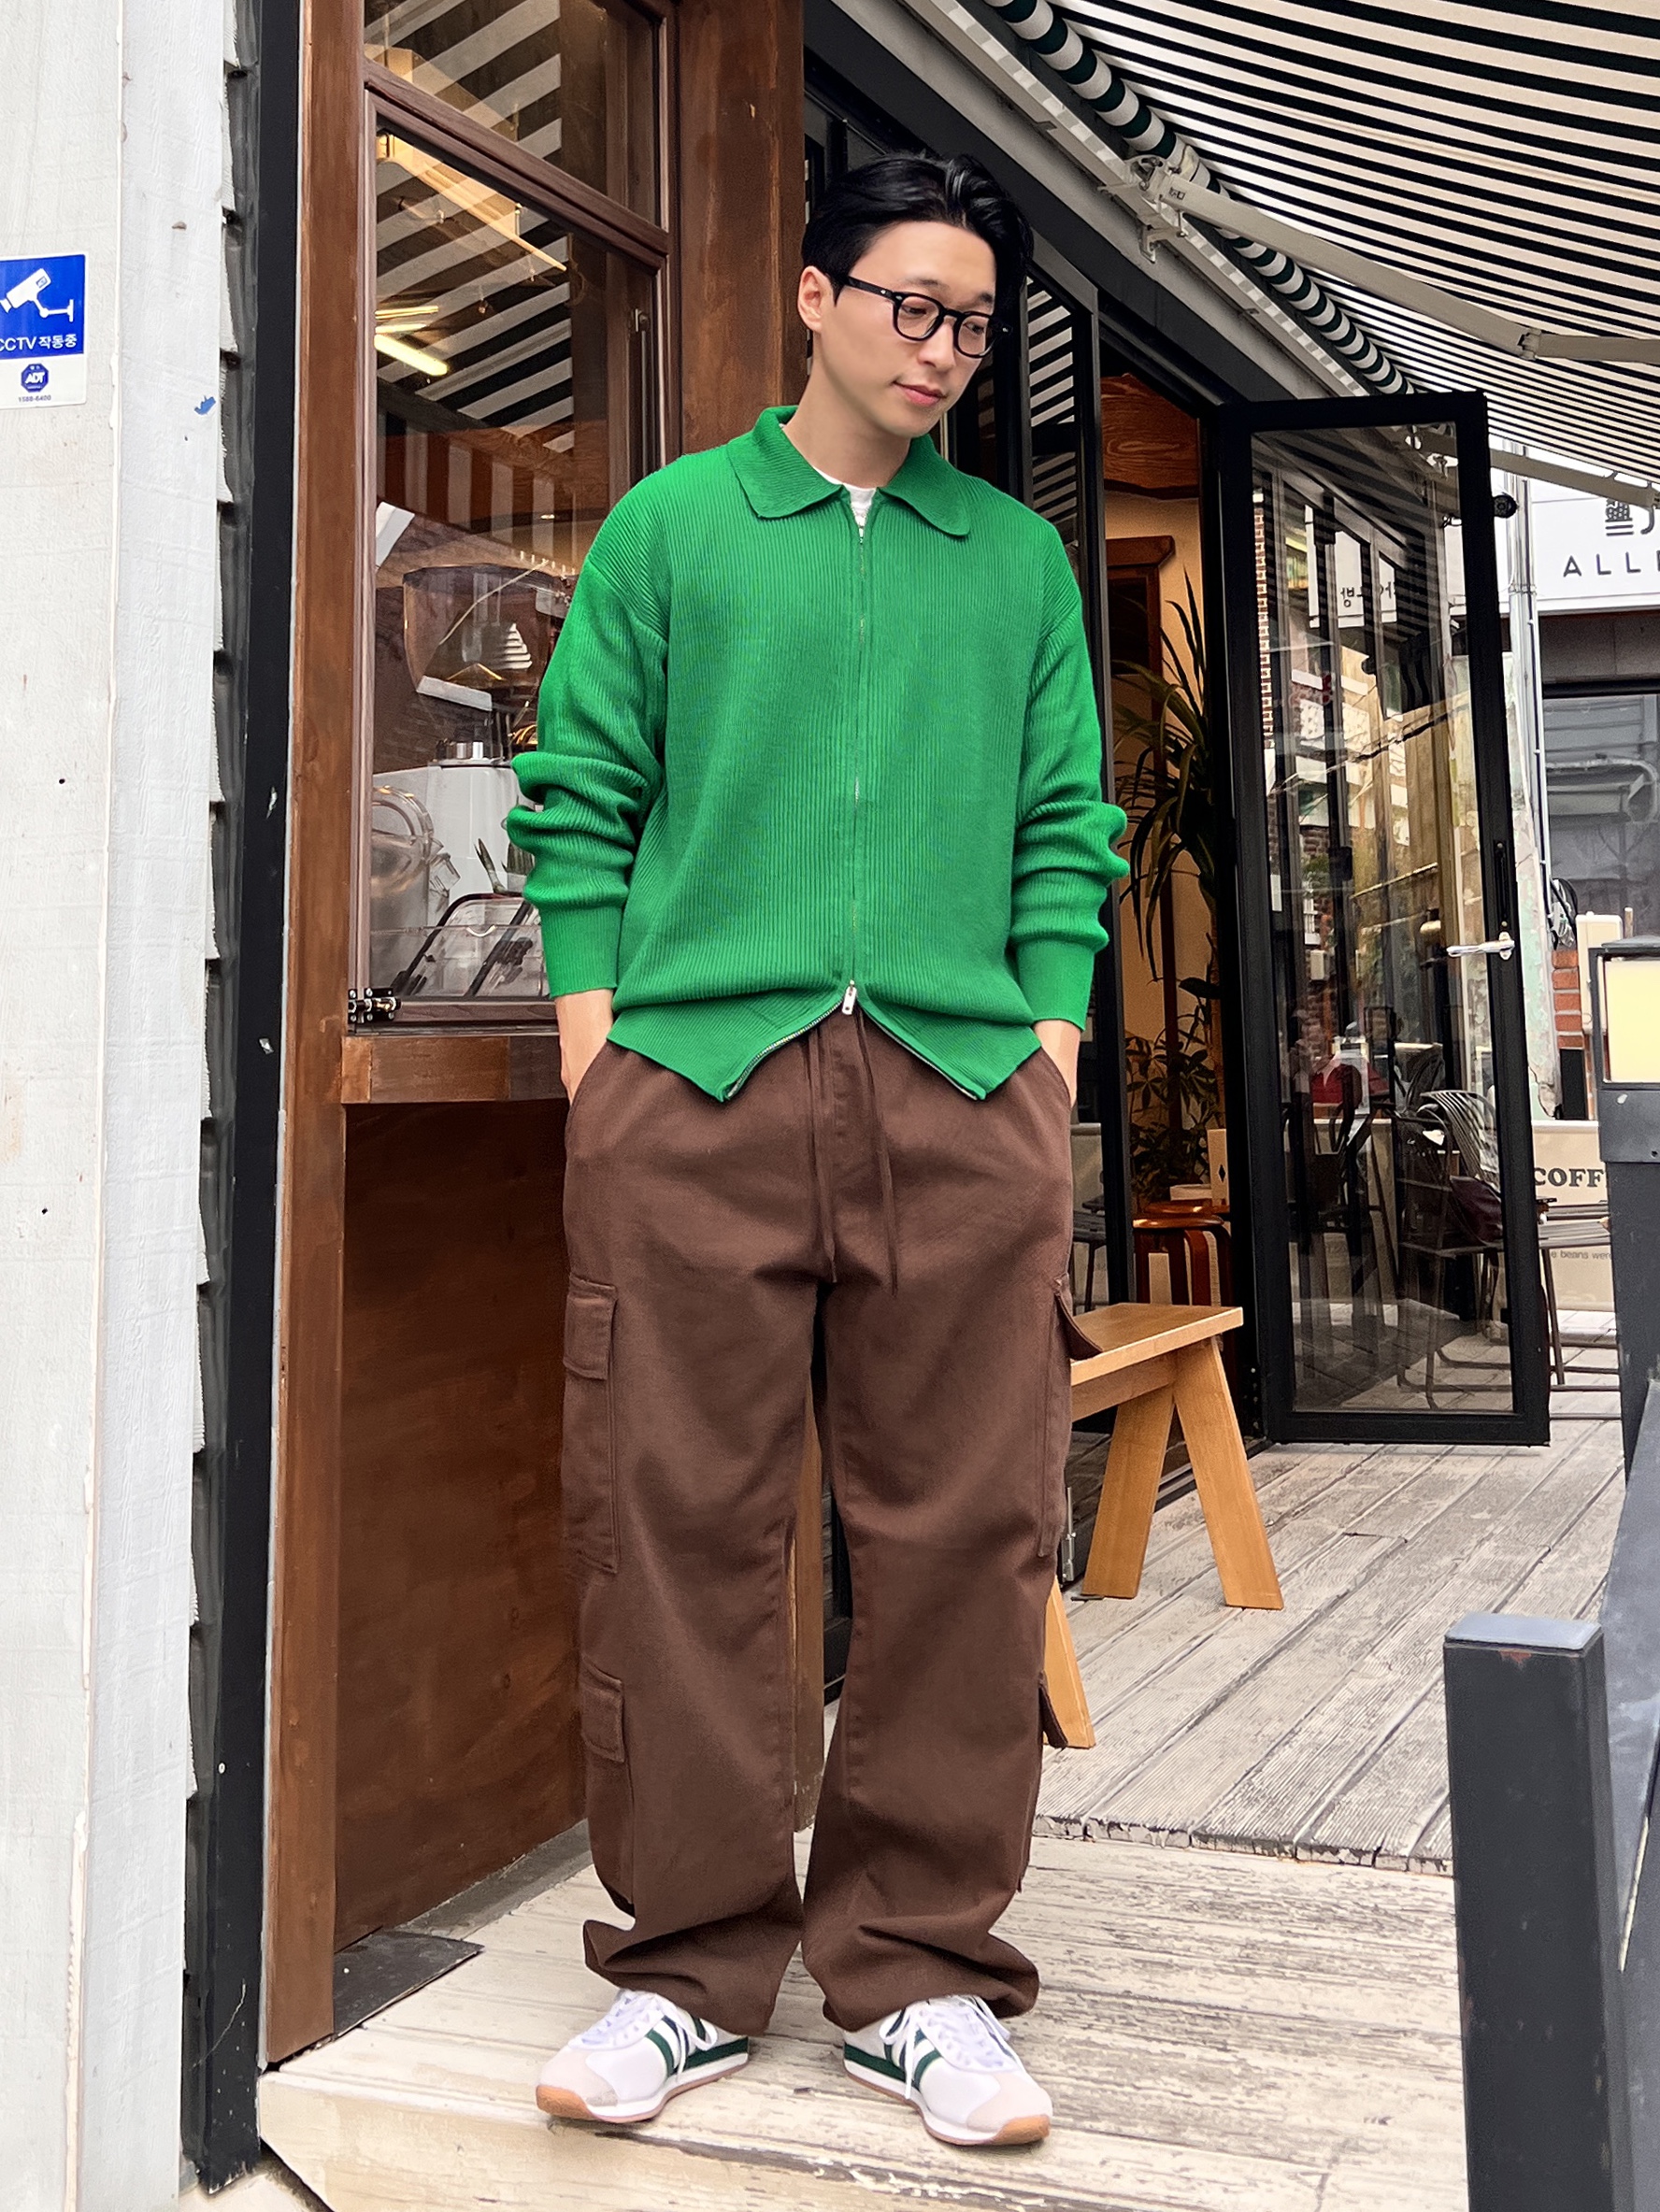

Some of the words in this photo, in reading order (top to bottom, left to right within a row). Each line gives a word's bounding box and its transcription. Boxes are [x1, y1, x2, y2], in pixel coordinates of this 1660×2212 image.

[38, 334, 78, 350] 작동중
[24, 371, 45, 384] ADT
[1563, 549, 1660, 578] ALL
[1534, 1167, 1607, 1188] COFF
